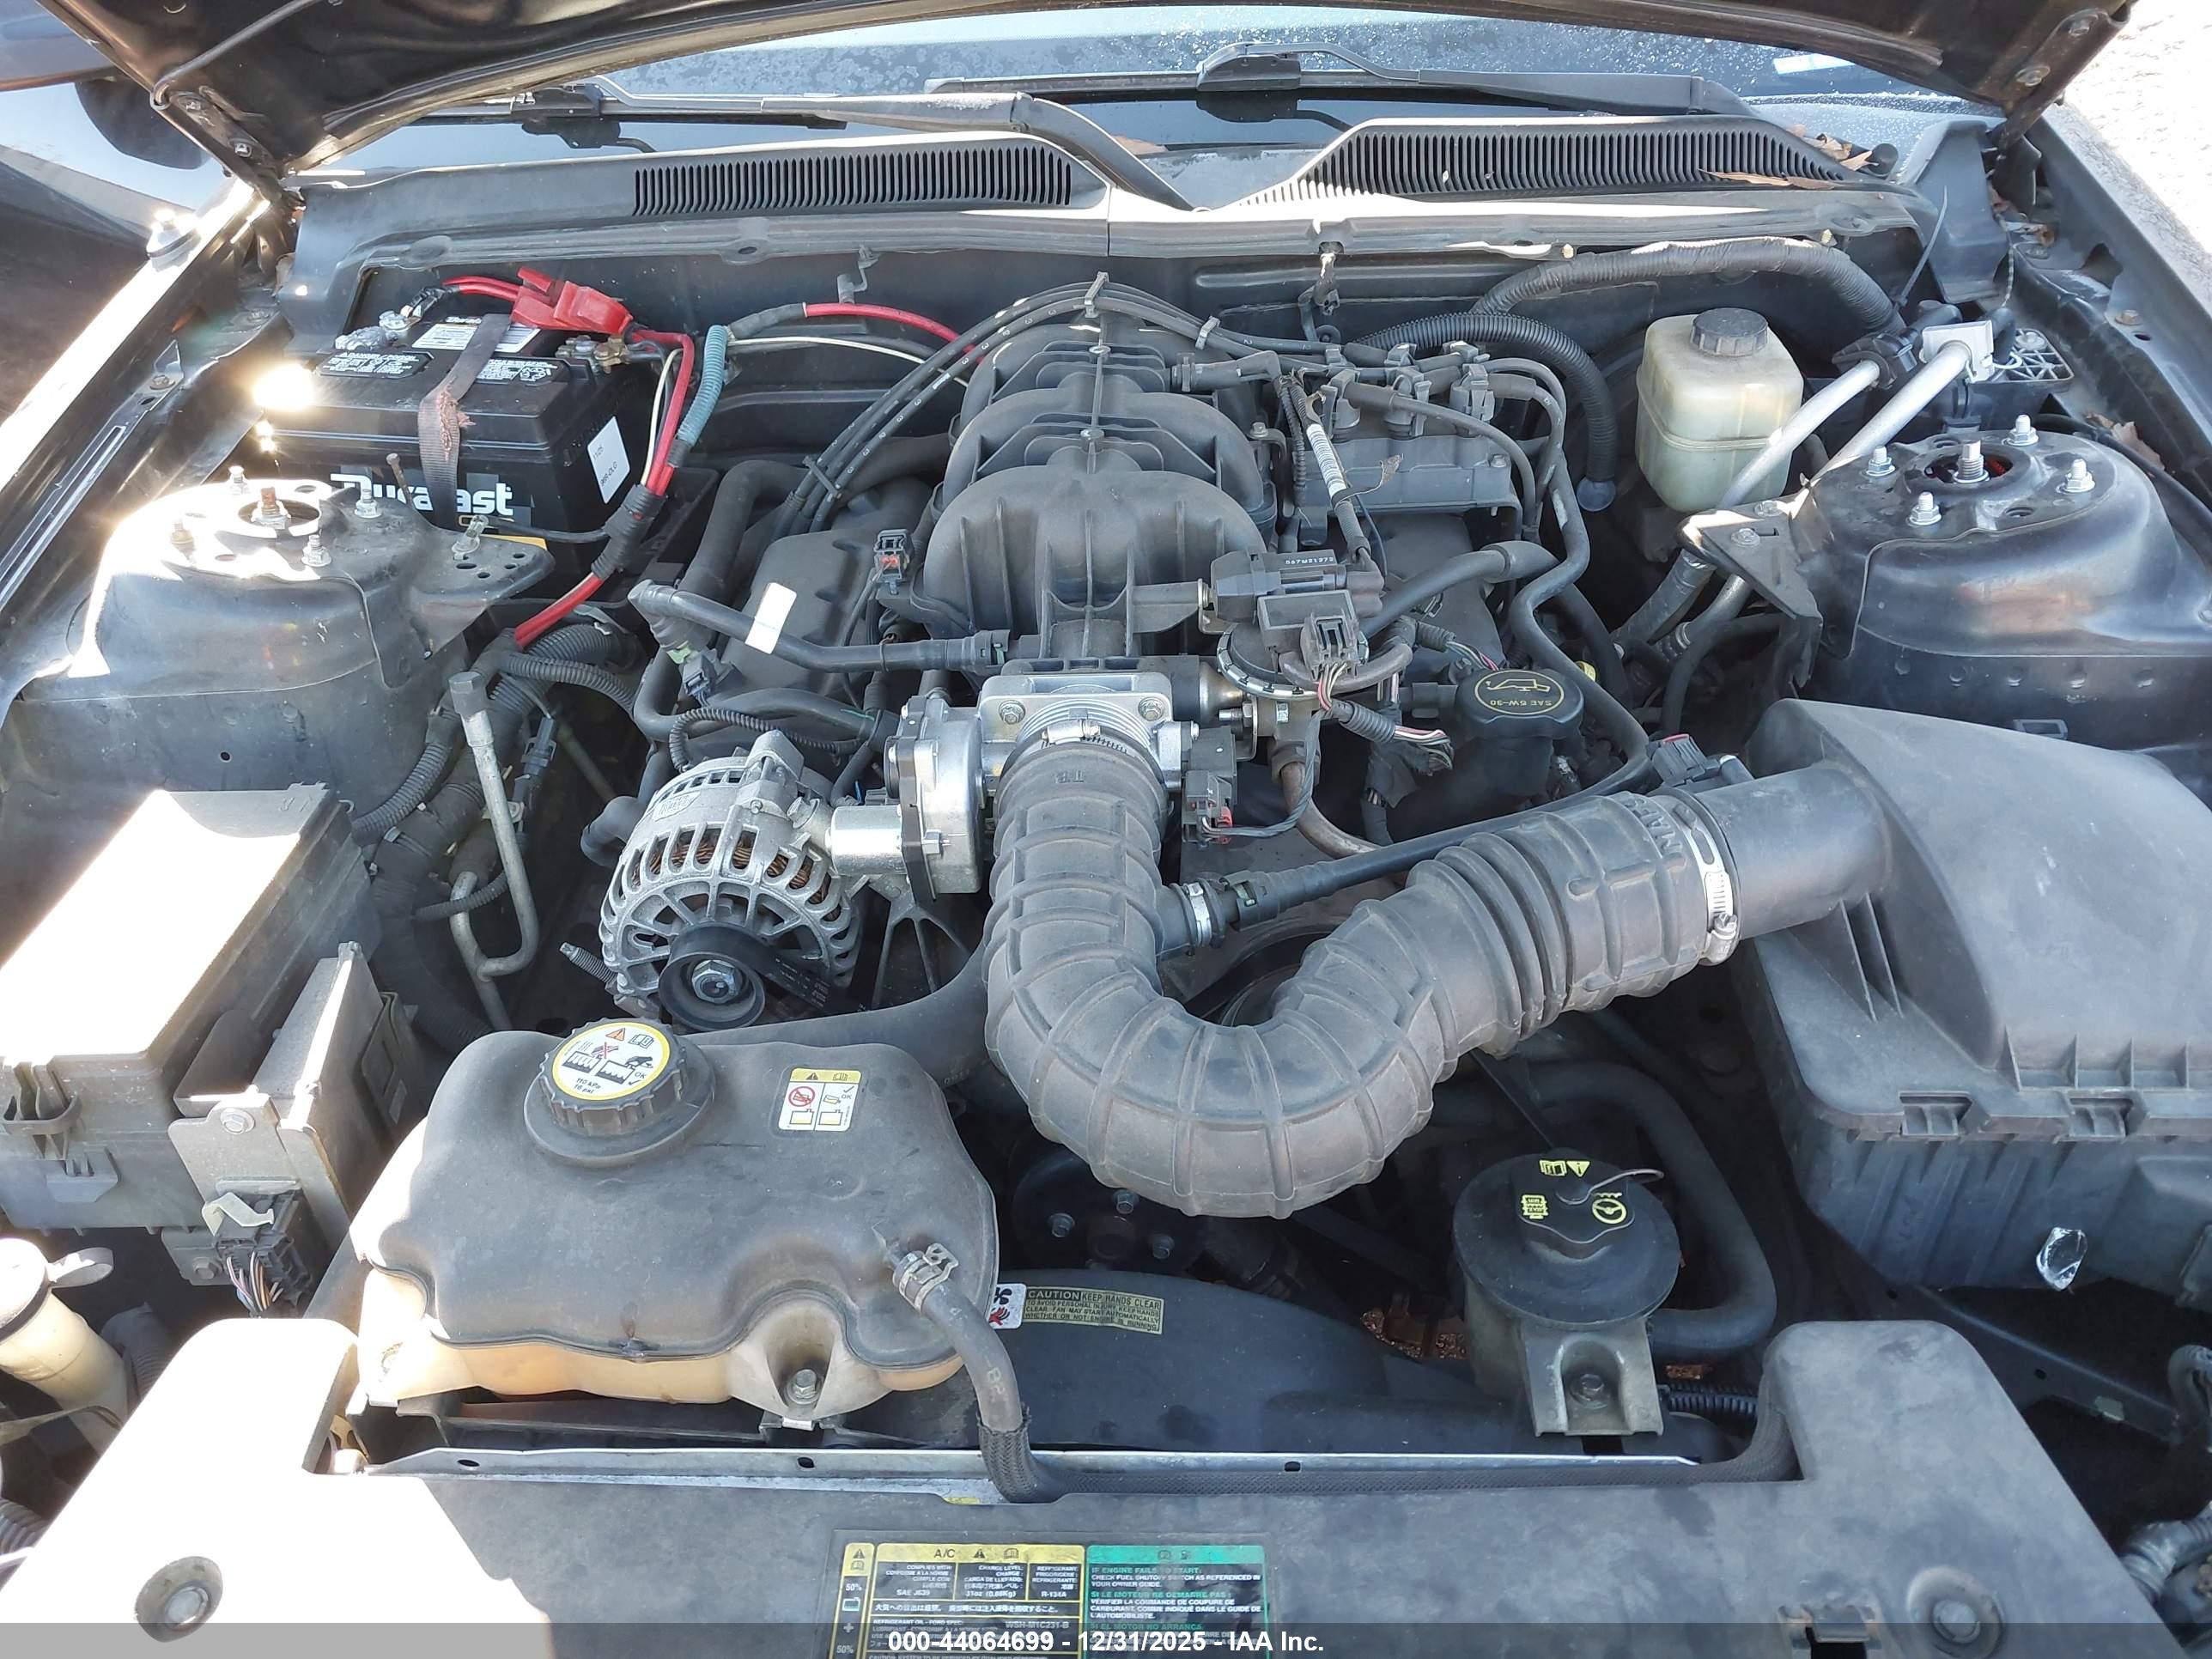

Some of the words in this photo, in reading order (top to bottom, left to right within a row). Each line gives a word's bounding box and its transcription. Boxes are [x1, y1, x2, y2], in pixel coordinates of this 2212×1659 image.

[331, 473, 514, 516] Duraast
[588, 1080, 601, 1090] kPa
[583, 1086, 595, 1095] psi
[1028, 1290, 1080, 1300] CAUTION
[1082, 1291, 1103, 1302] KEEP
[1105, 1294, 1132, 1306] HANDS
[1134, 1298, 1160, 1310] CLEAR
[1084, 1308, 1104, 1316] START
[1105, 1310, 1159, 1323] AUTOMATICALLY
[1127, 1320, 1158, 1330] RUNNING
[933, 1548, 956, 1559] A/C
[845, 1583, 863, 1591] 50%
[836, 1644, 854, 1654] 50%
